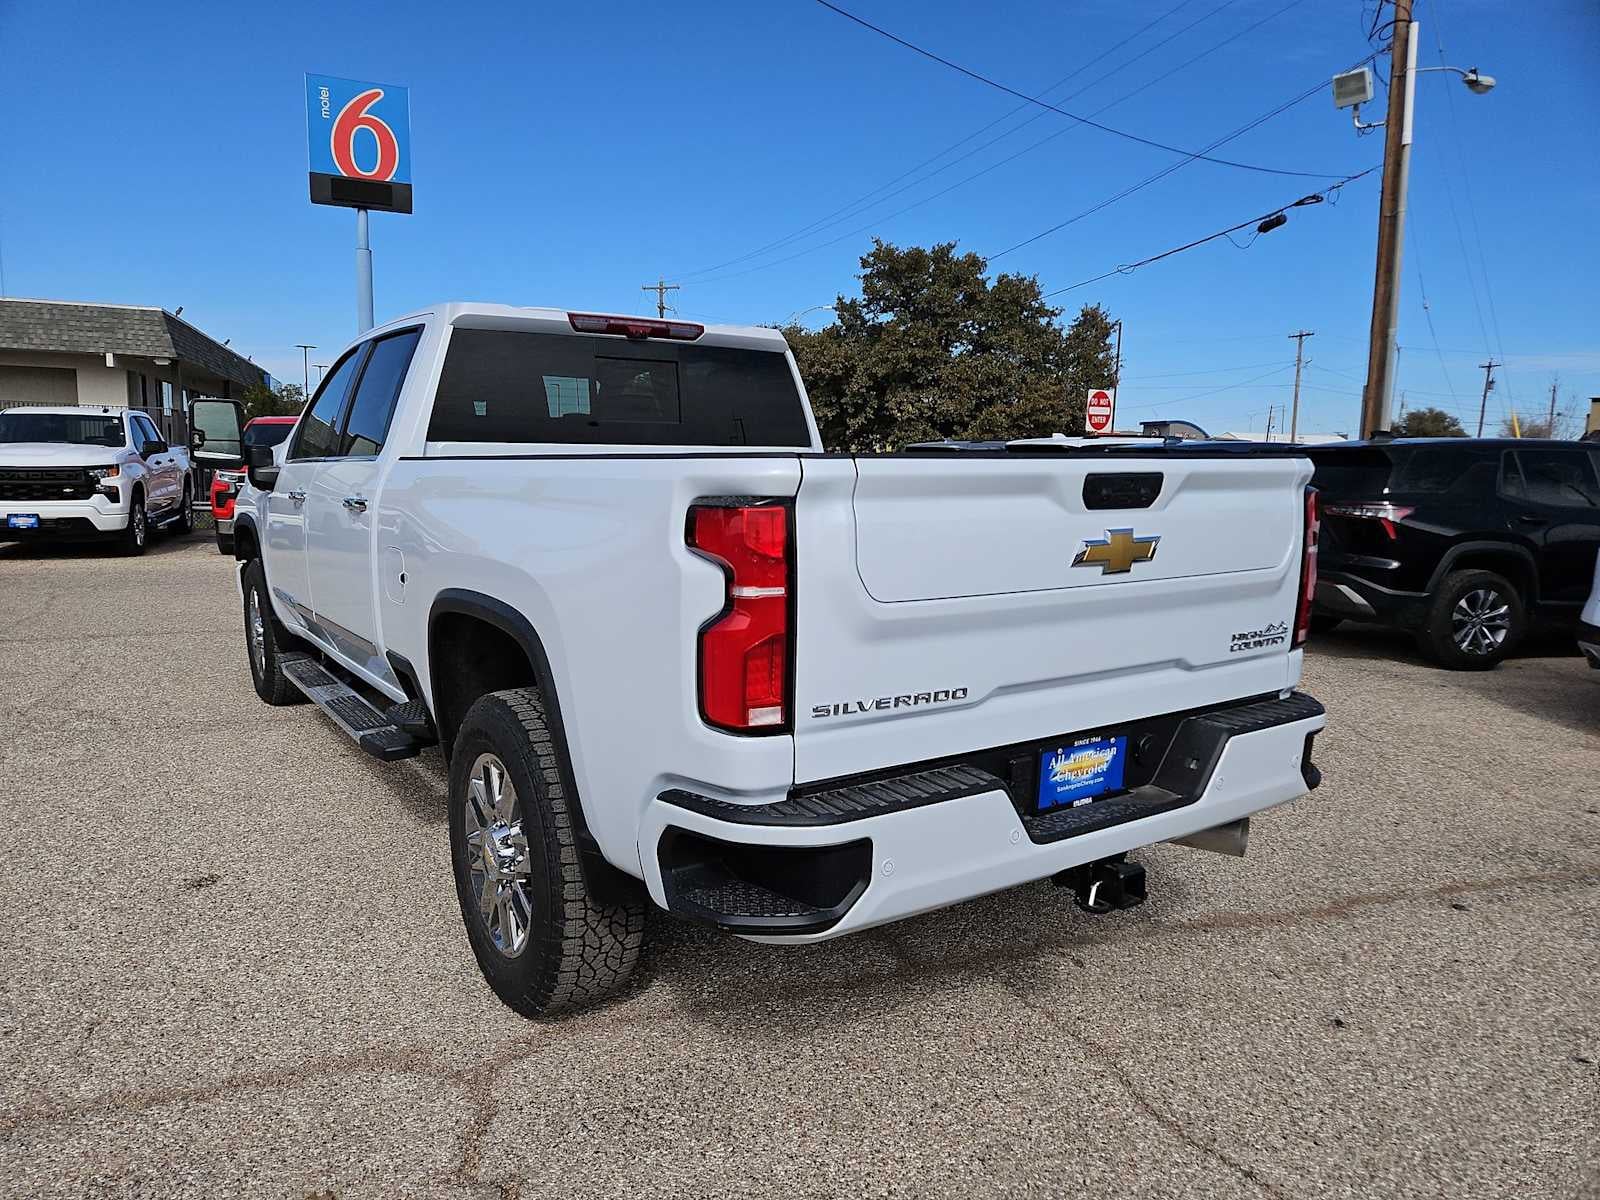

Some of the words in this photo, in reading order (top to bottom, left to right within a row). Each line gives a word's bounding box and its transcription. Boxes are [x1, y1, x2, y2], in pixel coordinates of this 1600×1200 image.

[318, 86, 330, 119] motel
[330, 88, 399, 181] 6
[1091, 398, 1098, 406] DO
[1100, 398, 1109, 406] NOT
[1091, 415, 1107, 424] ENTER
[1230, 636, 1285, 652] COUNTRY
[1231, 630, 1264, 642] HIGH
[811, 687, 968, 719] SILVERADO
[1073, 737, 1090, 747] SINCE
[1048, 753, 1066, 770] All
[1057, 761, 1107, 783] Chevrolet
